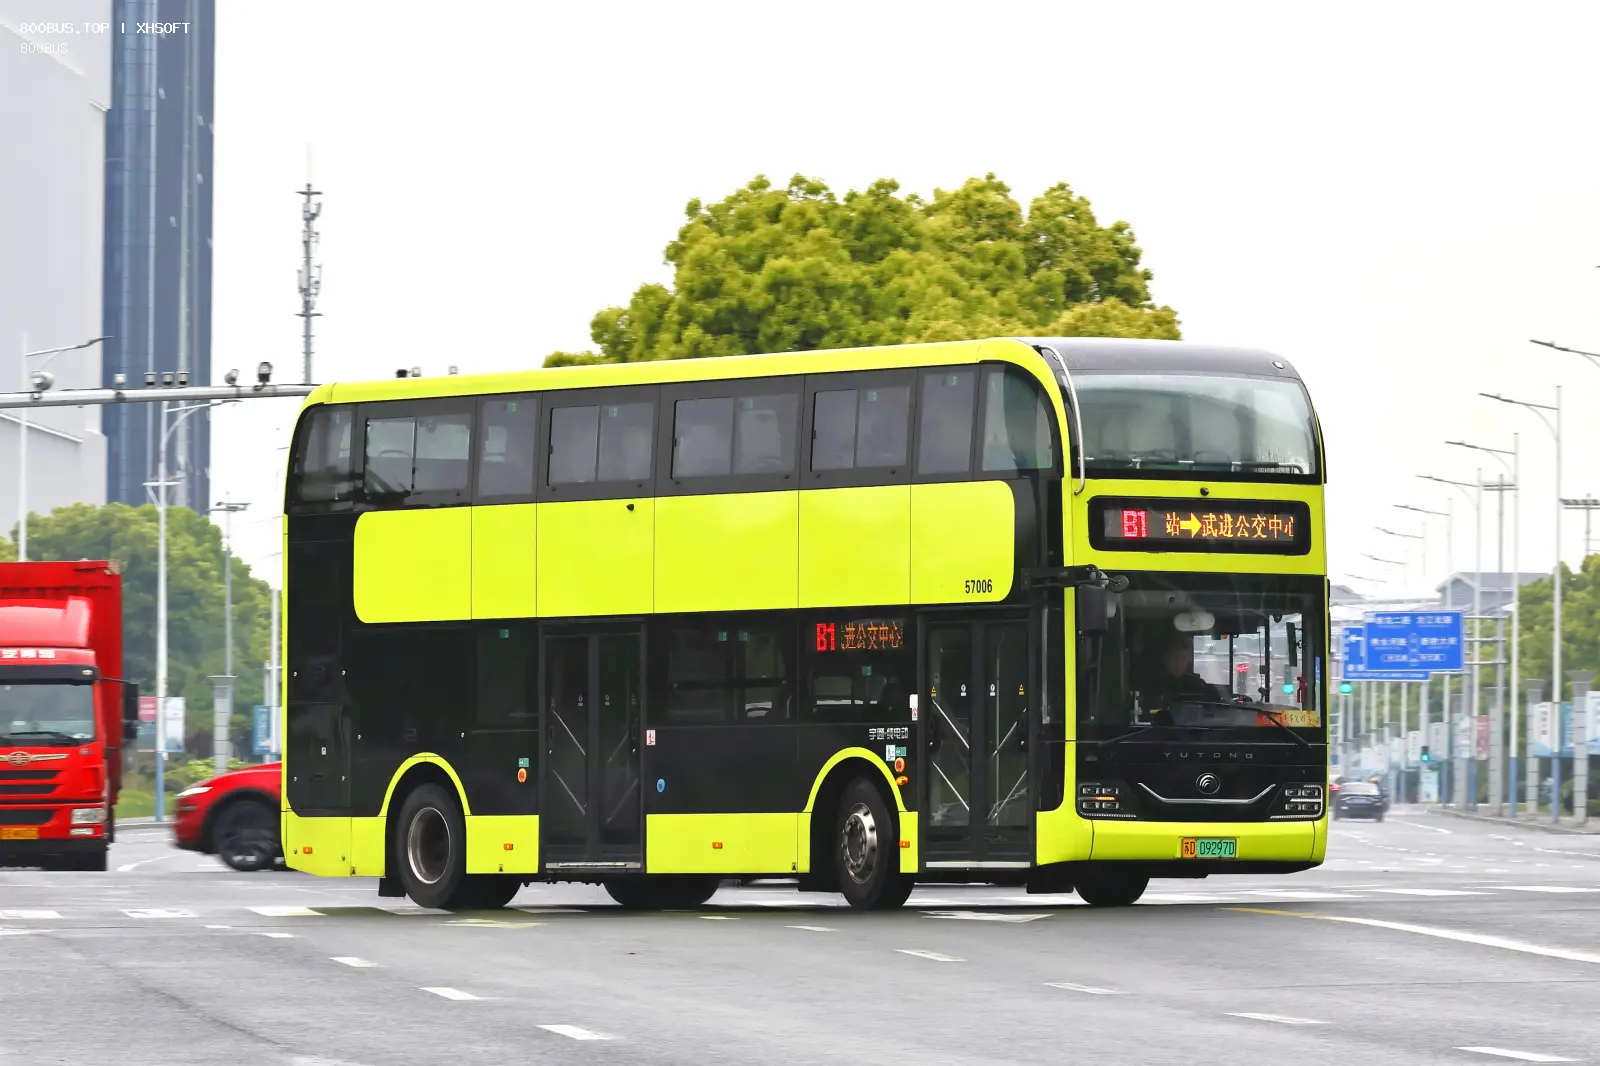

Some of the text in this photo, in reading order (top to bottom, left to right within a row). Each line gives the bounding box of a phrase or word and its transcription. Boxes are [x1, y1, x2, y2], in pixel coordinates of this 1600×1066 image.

[1122, 509, 1148, 538] B1
[965, 578, 993, 594] 57006
[816, 622, 836, 651] B1
[841, 620, 903, 650] 进公交中心
[1199, 841, 1235, 855] 09297D
